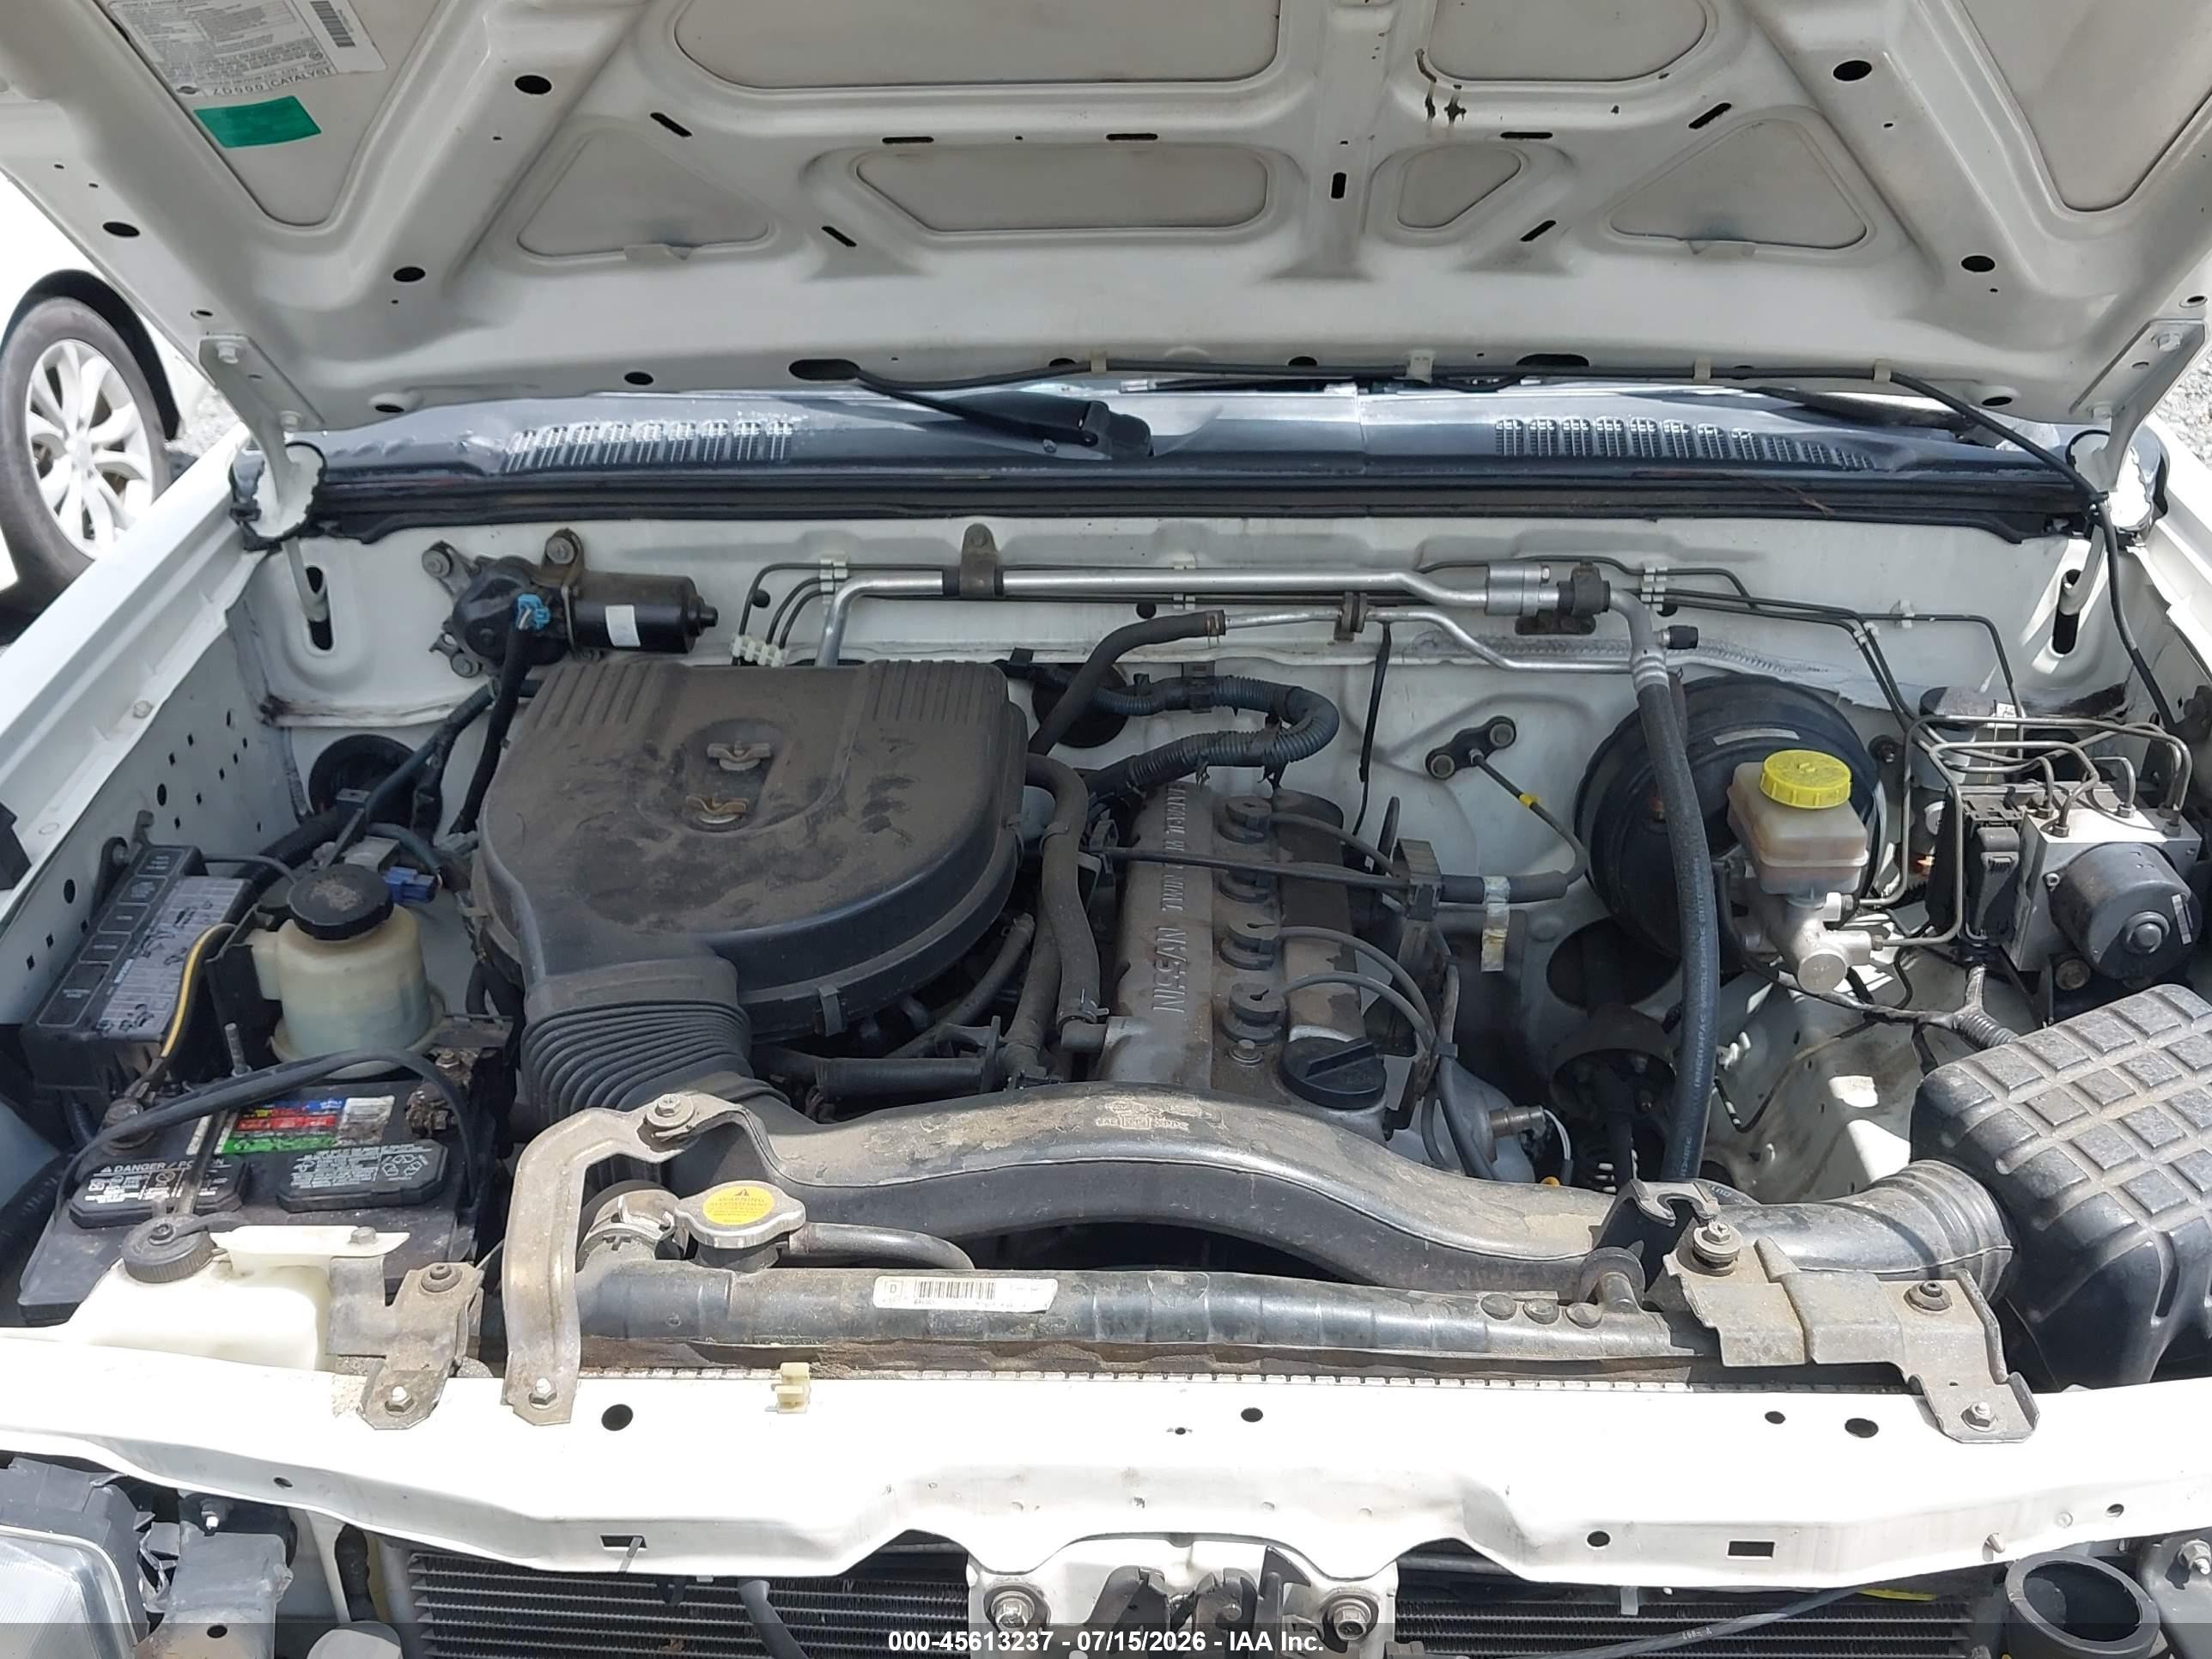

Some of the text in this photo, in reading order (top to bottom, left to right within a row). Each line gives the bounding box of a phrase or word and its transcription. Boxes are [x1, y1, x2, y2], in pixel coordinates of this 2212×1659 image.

[270, 67, 331, 88] CATALYST
[1152, 927, 1187, 1013] NISSAN
[114, 1161, 166, 1172] DANGER
[890, 1284, 897, 1292] D
